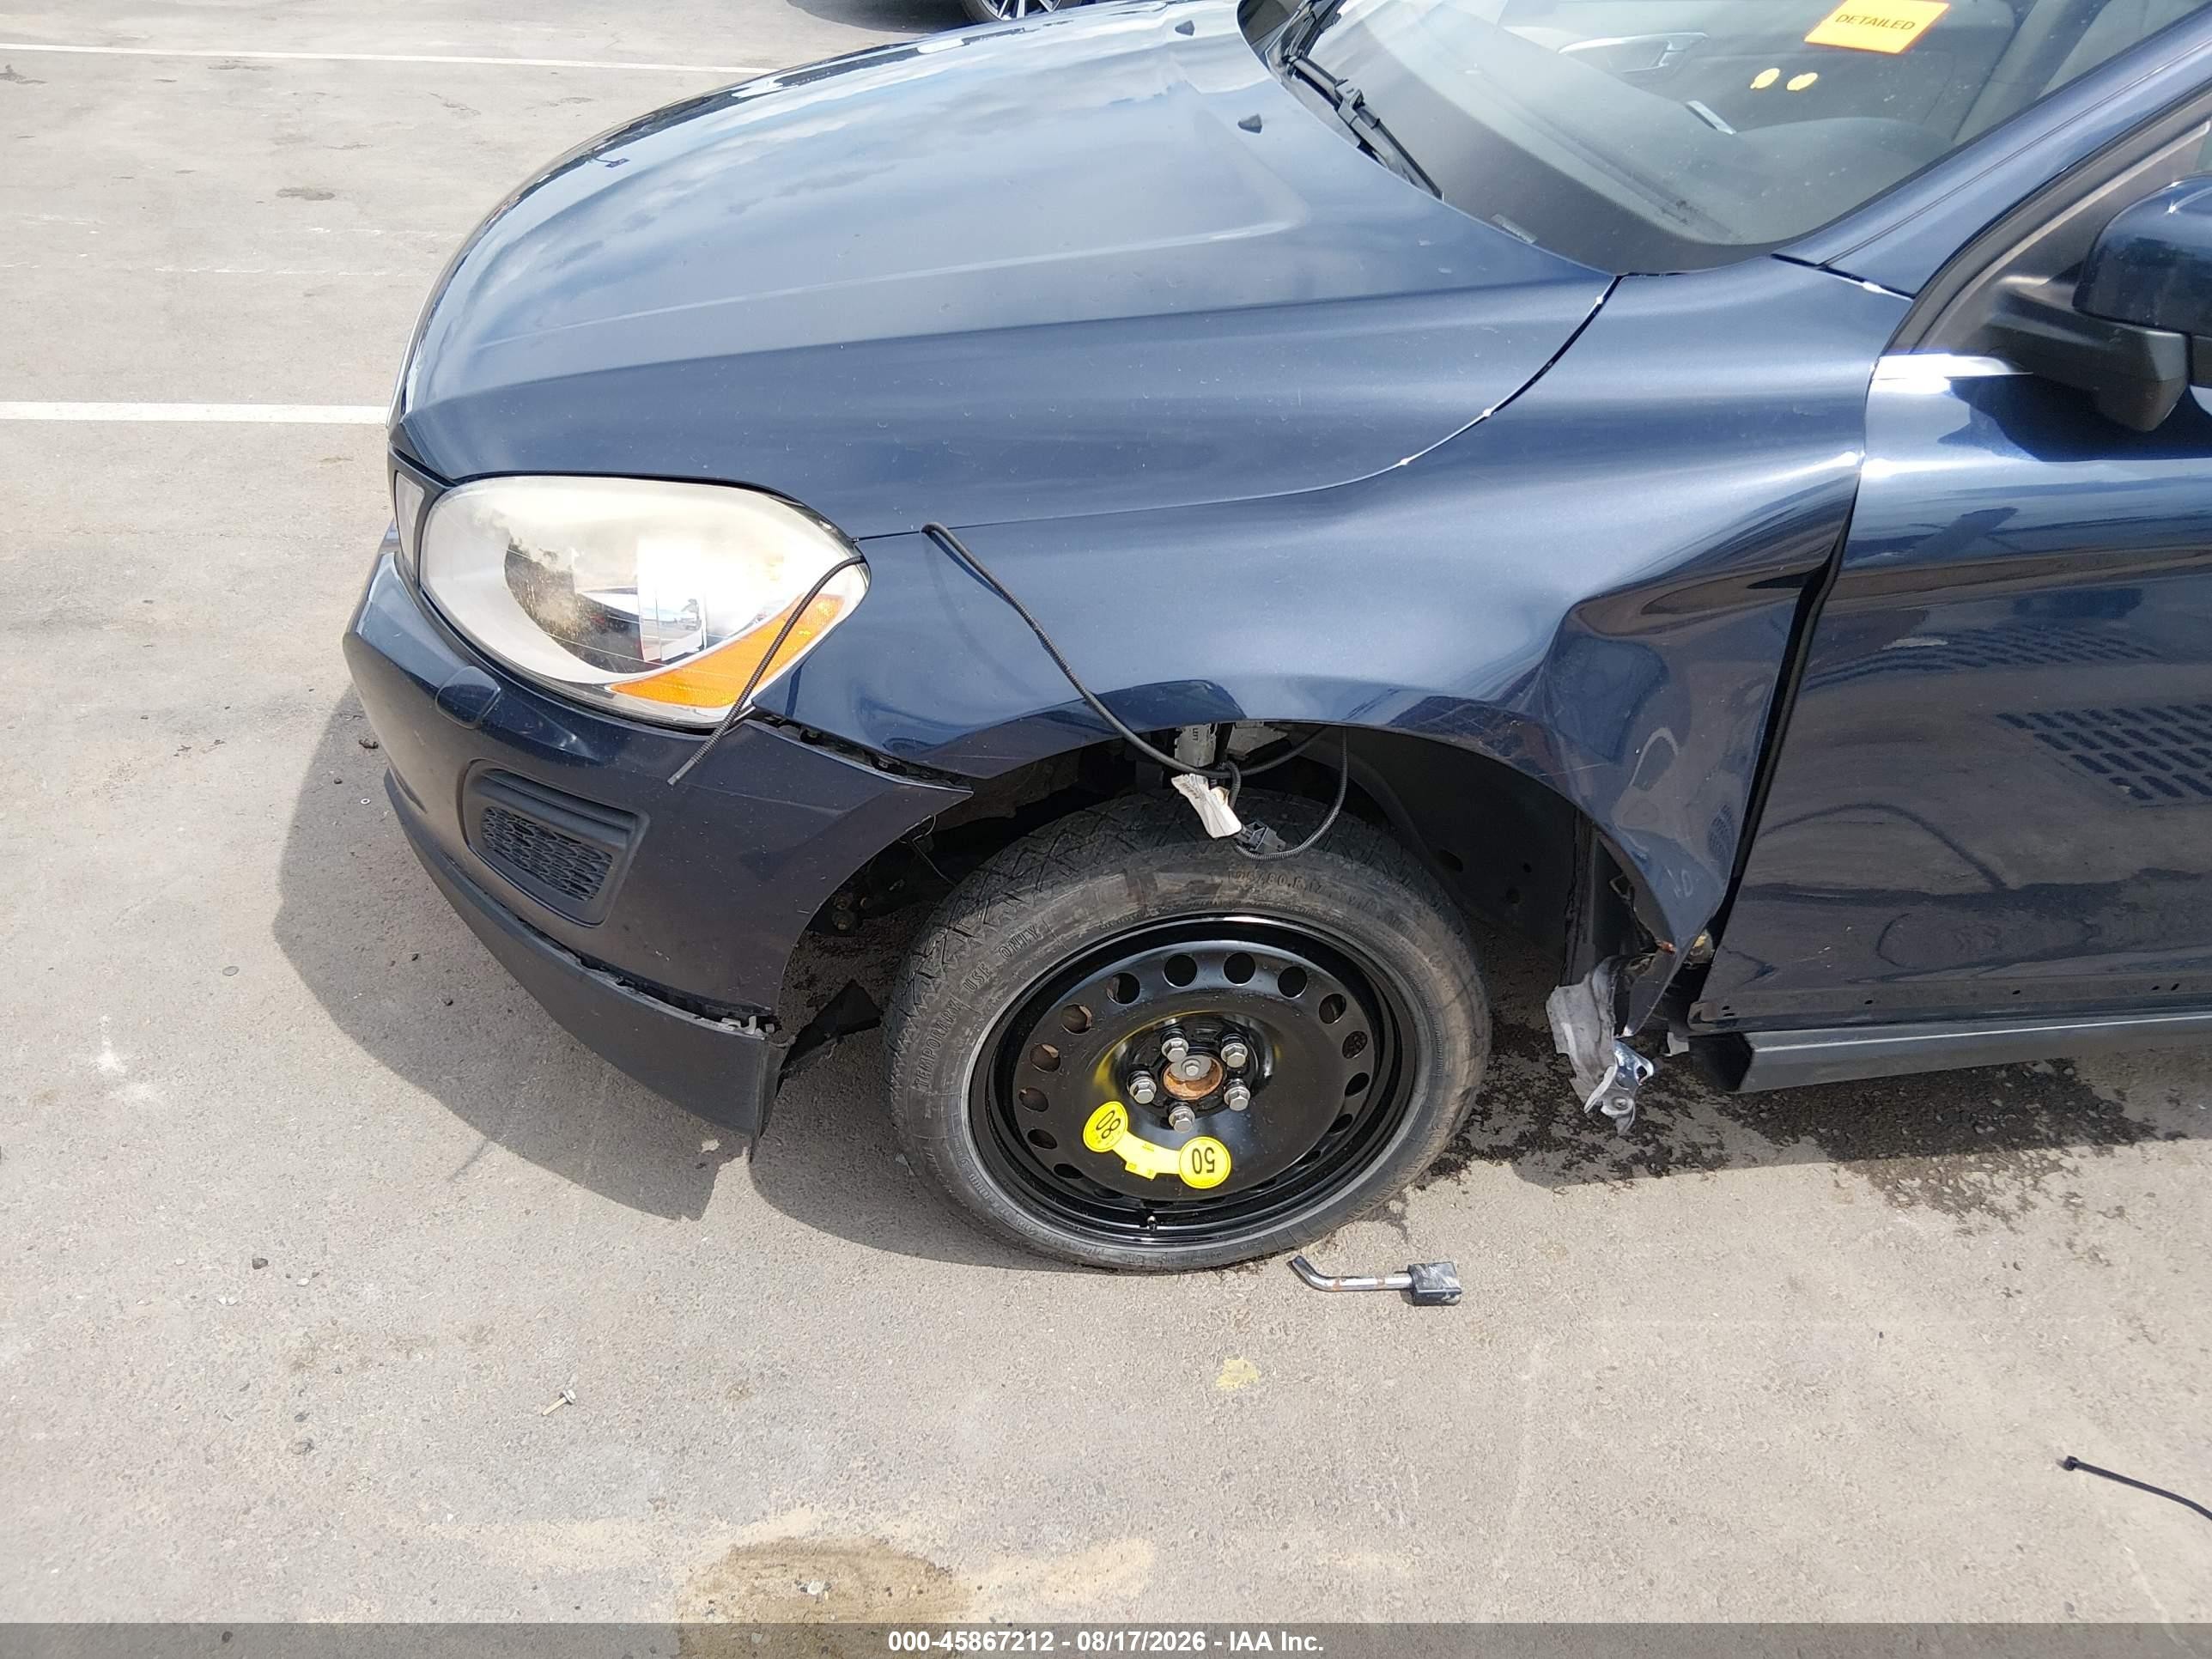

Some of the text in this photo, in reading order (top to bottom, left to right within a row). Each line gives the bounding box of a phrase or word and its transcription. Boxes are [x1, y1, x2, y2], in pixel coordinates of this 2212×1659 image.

[1835, 14, 1916, 30] DETAILED
[915, 924, 1041, 1088] TEMPORARY USE ONLY
[1095, 1109, 1121, 1140] 80
[1191, 1147, 1216, 1176] 50
